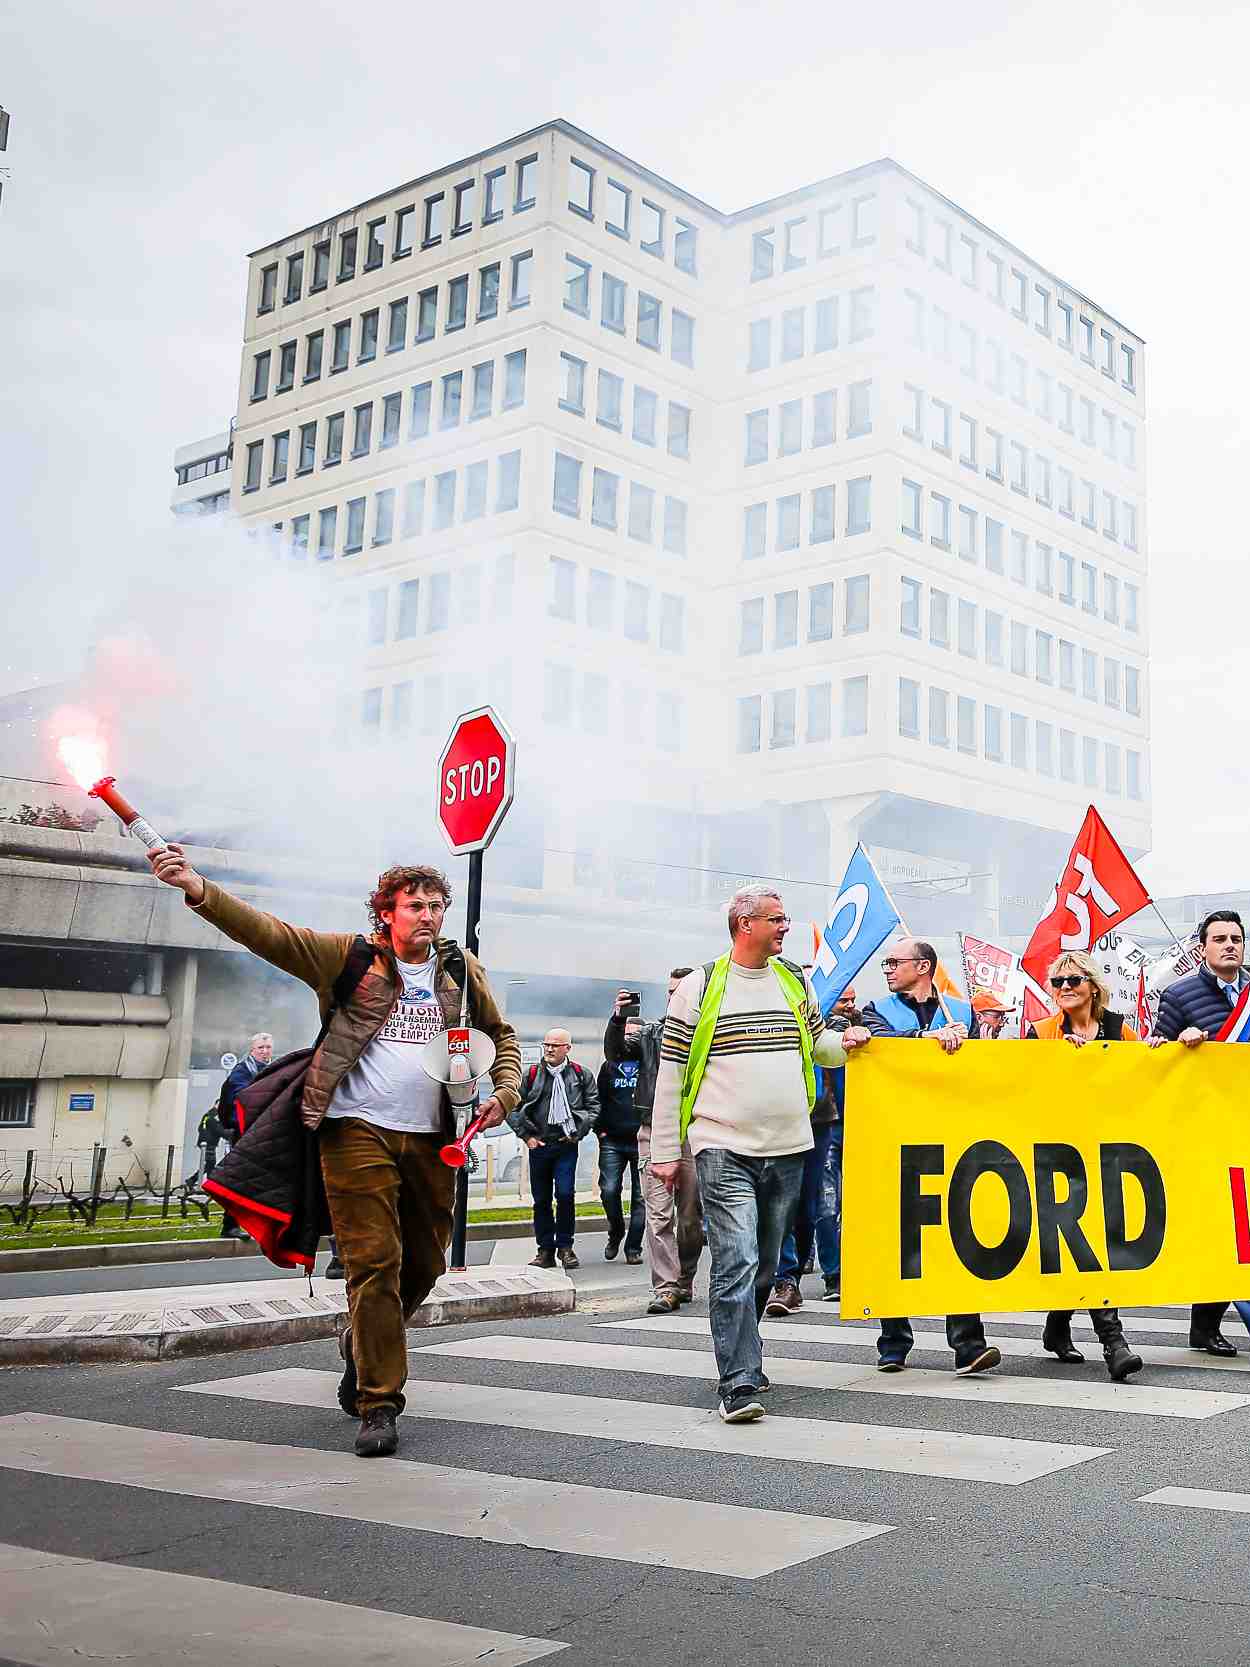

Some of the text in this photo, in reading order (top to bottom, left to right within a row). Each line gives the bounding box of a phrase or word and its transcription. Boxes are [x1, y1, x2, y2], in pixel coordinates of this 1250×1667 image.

[444, 756, 501, 805] STOP
[386, 1020, 405, 1029] OUR
[404, 1015, 444, 1025] ENSEMBL
[401, 1029, 437, 1041] EMPLO
[448, 1040, 470, 1053] cgt
[900, 1139, 1167, 1281] FORD
